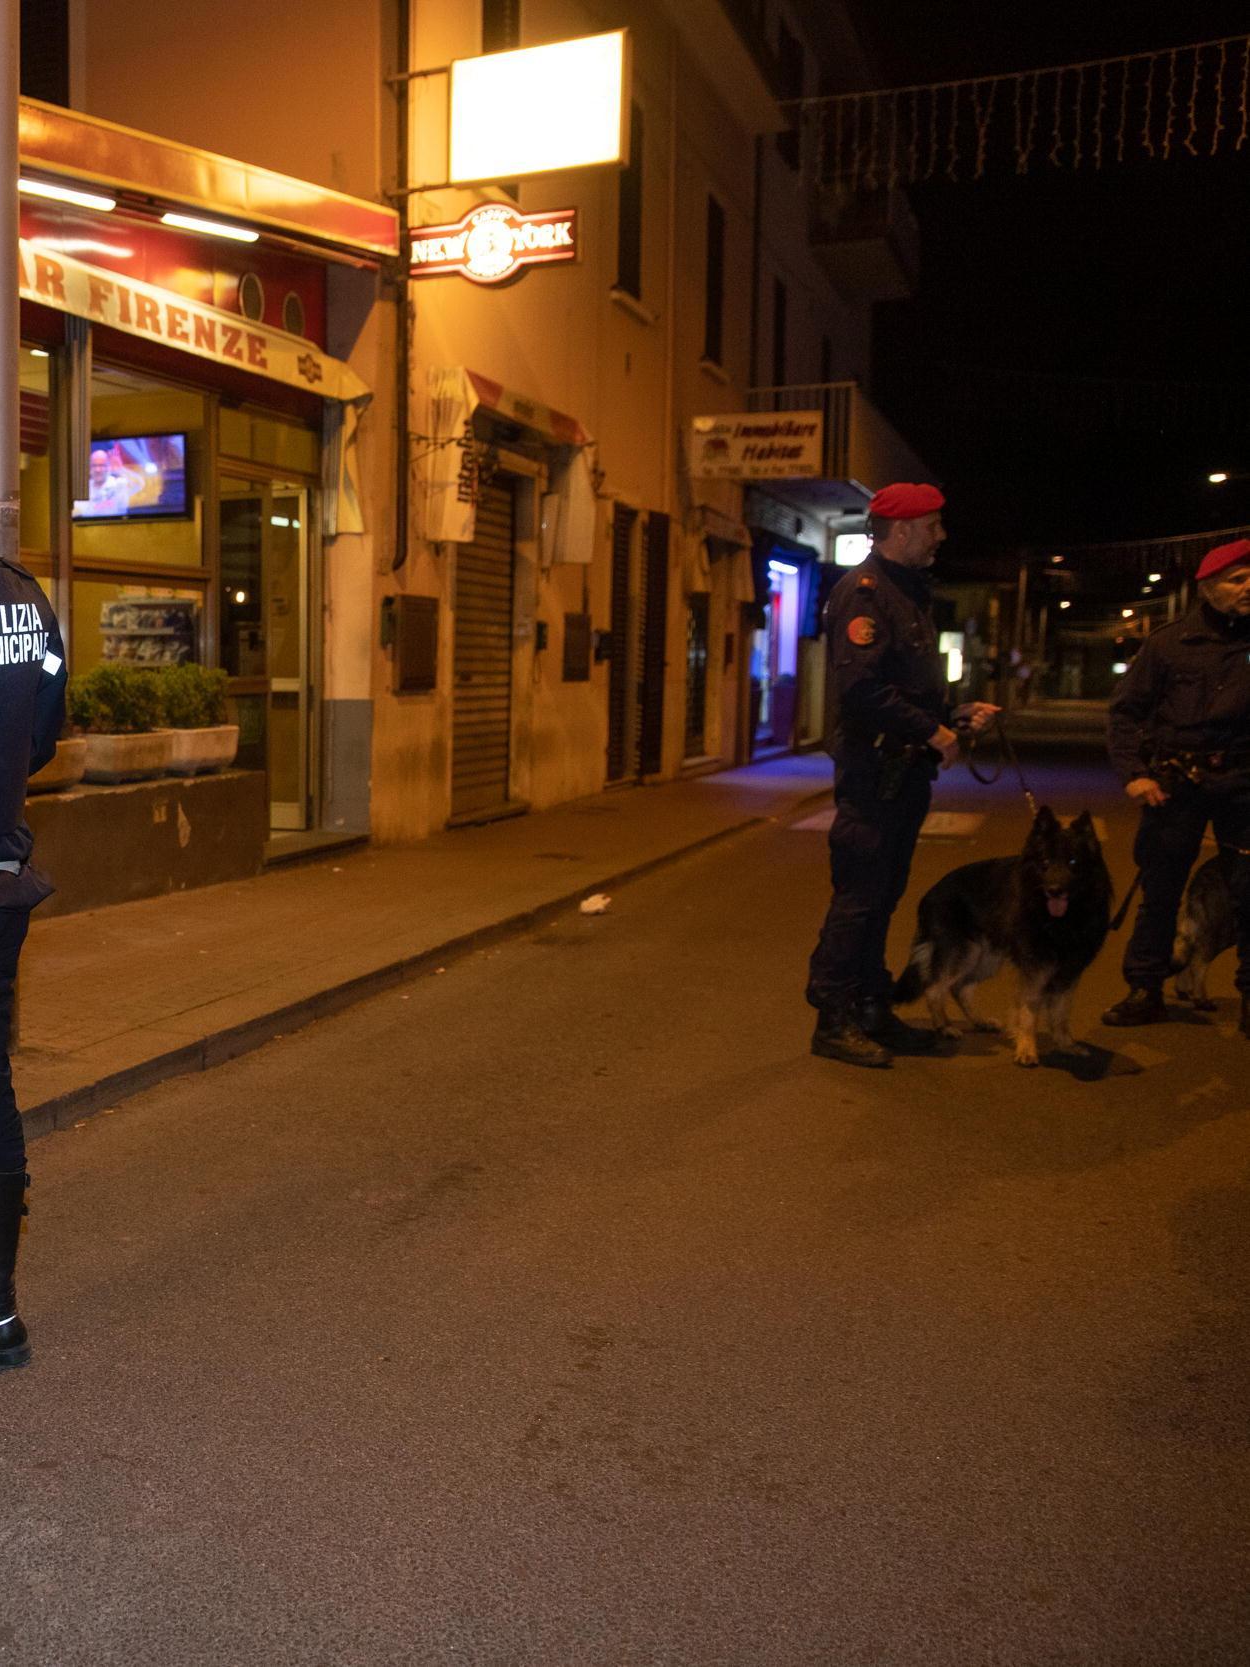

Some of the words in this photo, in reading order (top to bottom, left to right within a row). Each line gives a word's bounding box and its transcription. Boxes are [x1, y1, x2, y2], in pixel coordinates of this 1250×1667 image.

[411, 230, 469, 264] NEW
[510, 221, 574, 251] YORK
[88, 273, 268, 370] FIRENZE
